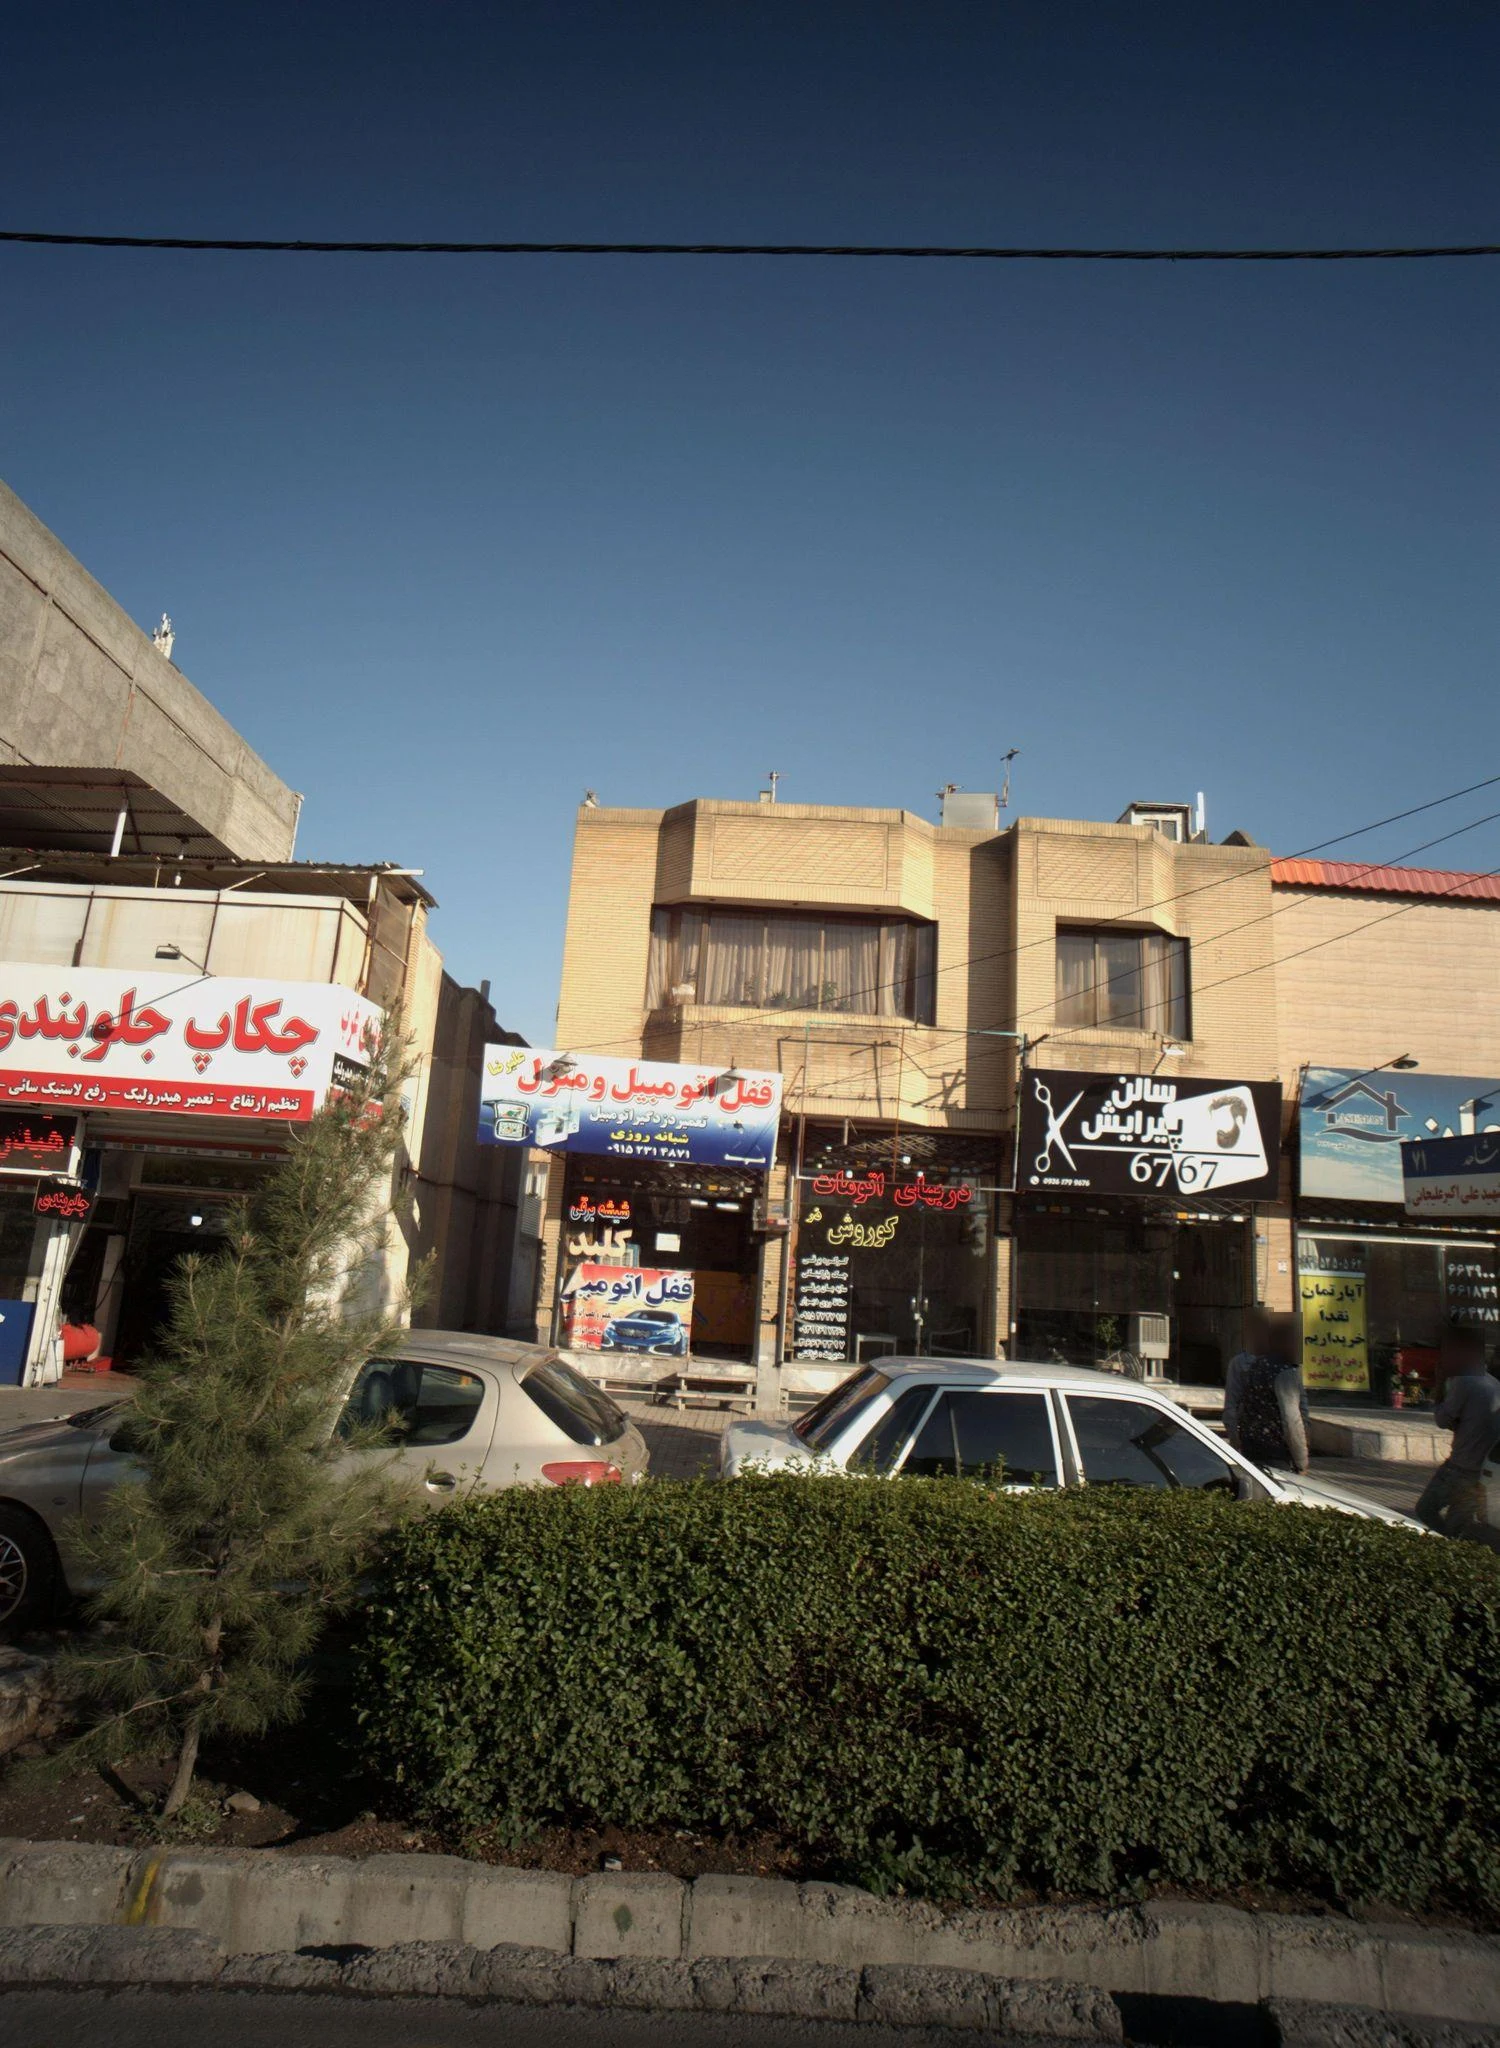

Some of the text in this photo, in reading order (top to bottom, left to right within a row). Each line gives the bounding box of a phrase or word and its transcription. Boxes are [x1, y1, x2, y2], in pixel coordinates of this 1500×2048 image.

[184, 994, 320, 1079] چکاپ
[486, 1050, 527, 1077] علیرضا
[41, 1080, 82, 1098] لاستیک
[84, 1084, 107, 1102] رفع
[123, 1087, 182, 1106] هیدرولیک
[516, 1057, 776, 1113] قفل اتومبیل و منزل
[1111, 1076, 1177, 1110] سالن
[183, 1091, 215, 1108] تعمیر
[229, 1093, 266, 1111] ارتفاع
[267, 1097, 301, 1112] تنظیم
[633, 1109, 677, 1129] دزدگیر
[675, 1115, 709, 1130] تعمیر
[1081, 1100, 1184, 1150] پیرایش
[609, 1129, 690, 1145] شبانه روزی
[813, 1169, 886, 1204] اتومات
[37, 1192, 90, 1218] جلوبندی
[570, 1196, 631, 1224] شیشه برقی
[569, 1226, 633, 1257] کلید
[827, 1214, 899, 1248] کوروش
[645, 1275, 694, 1307] قفل
[1302, 1283, 1365, 1302] آپارتمان
[1304, 1331, 1366, 1348] خریداریم
